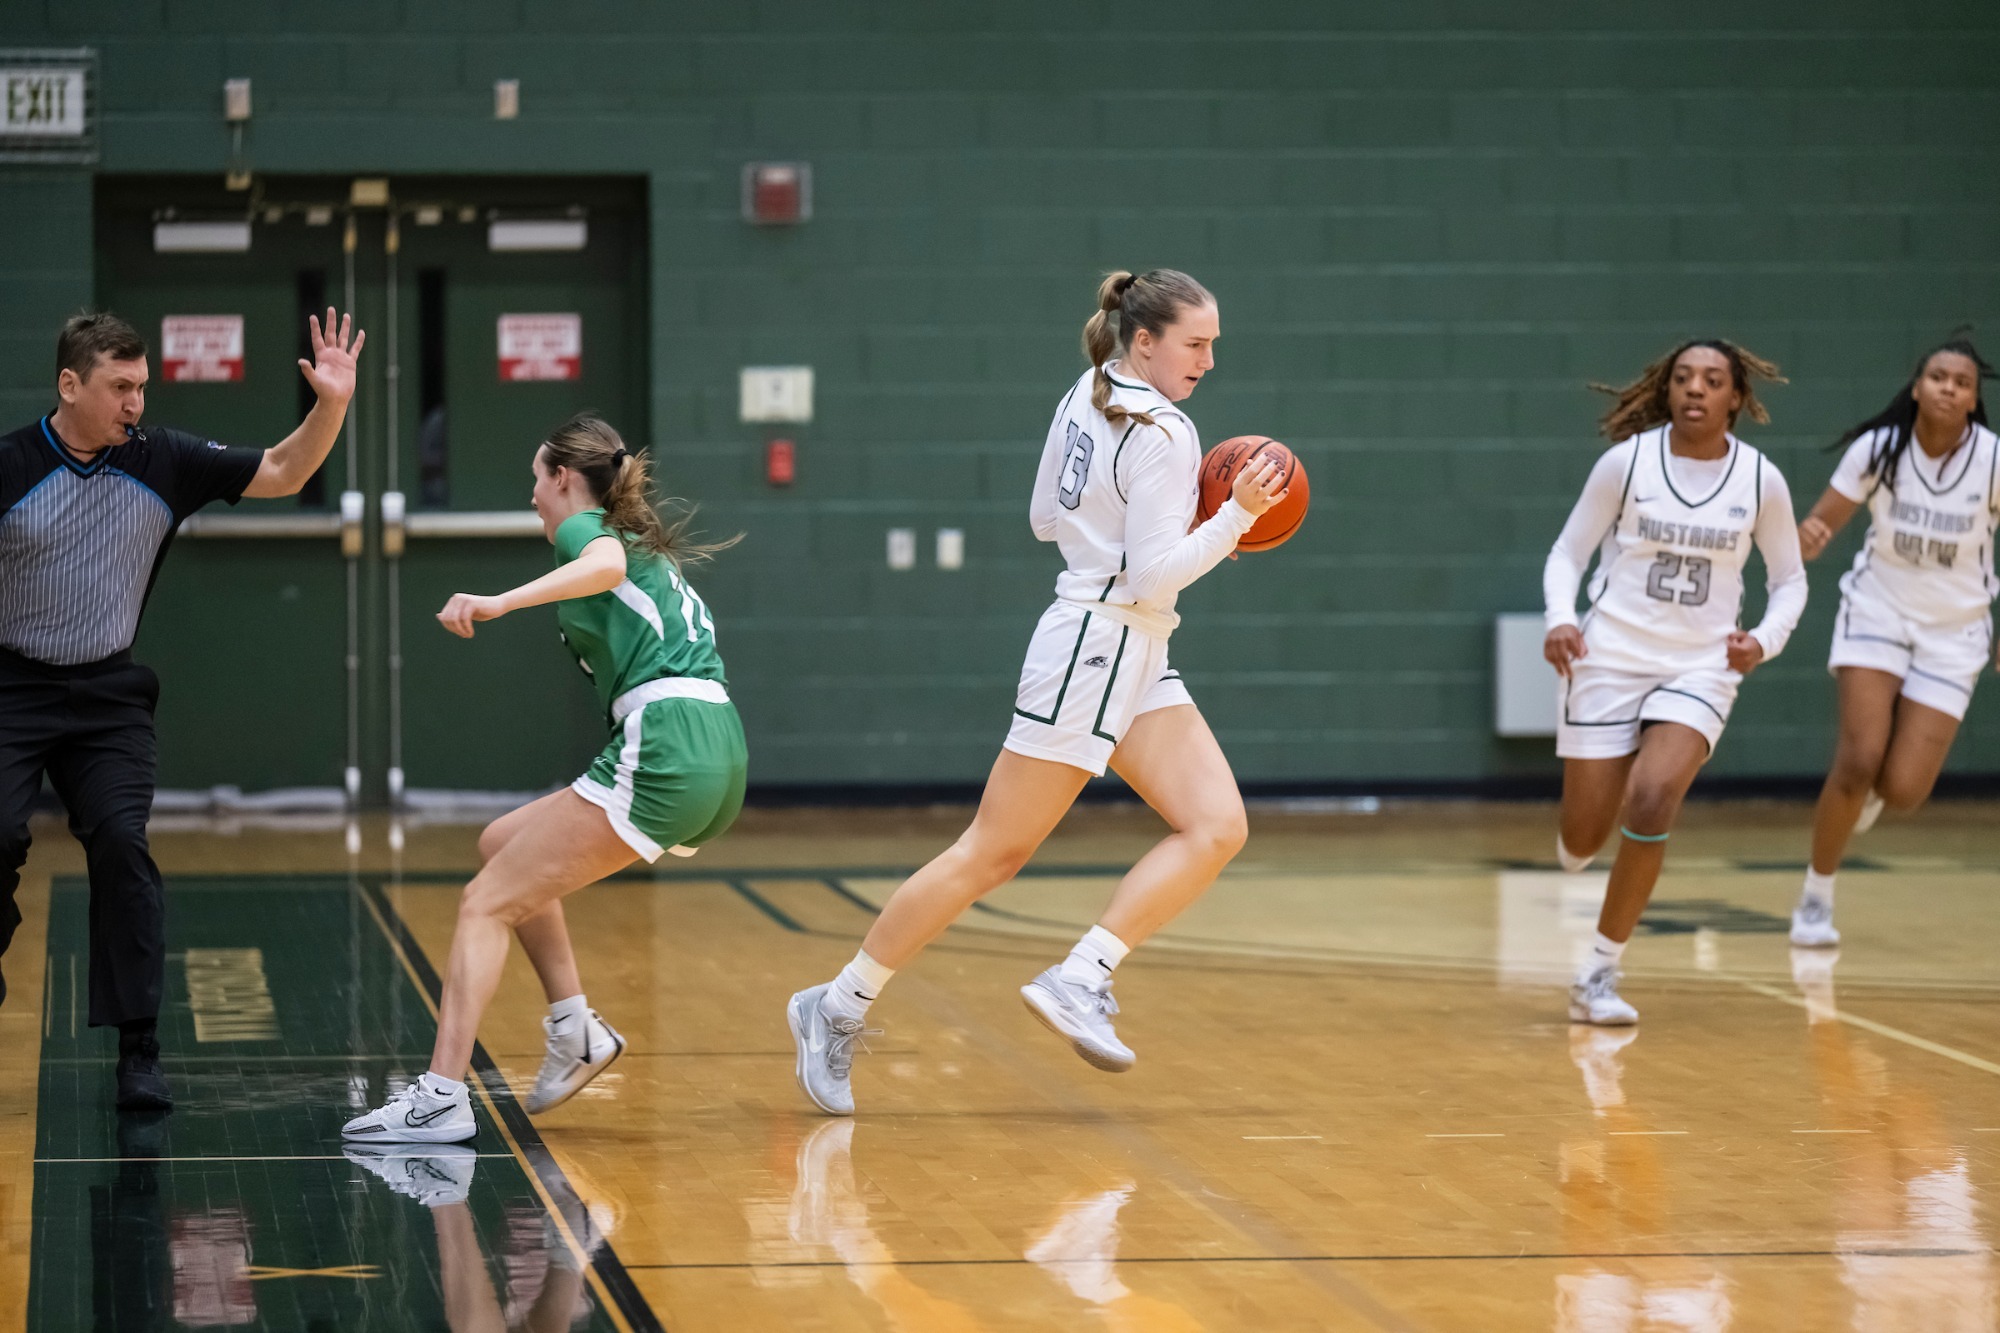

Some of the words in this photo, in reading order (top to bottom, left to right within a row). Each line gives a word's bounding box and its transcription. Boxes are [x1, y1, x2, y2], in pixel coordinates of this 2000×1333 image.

[7, 77, 67, 123] EXIT
[1637, 516, 1740, 551] MUSTANGS
[1646, 551, 1712, 607] 23
